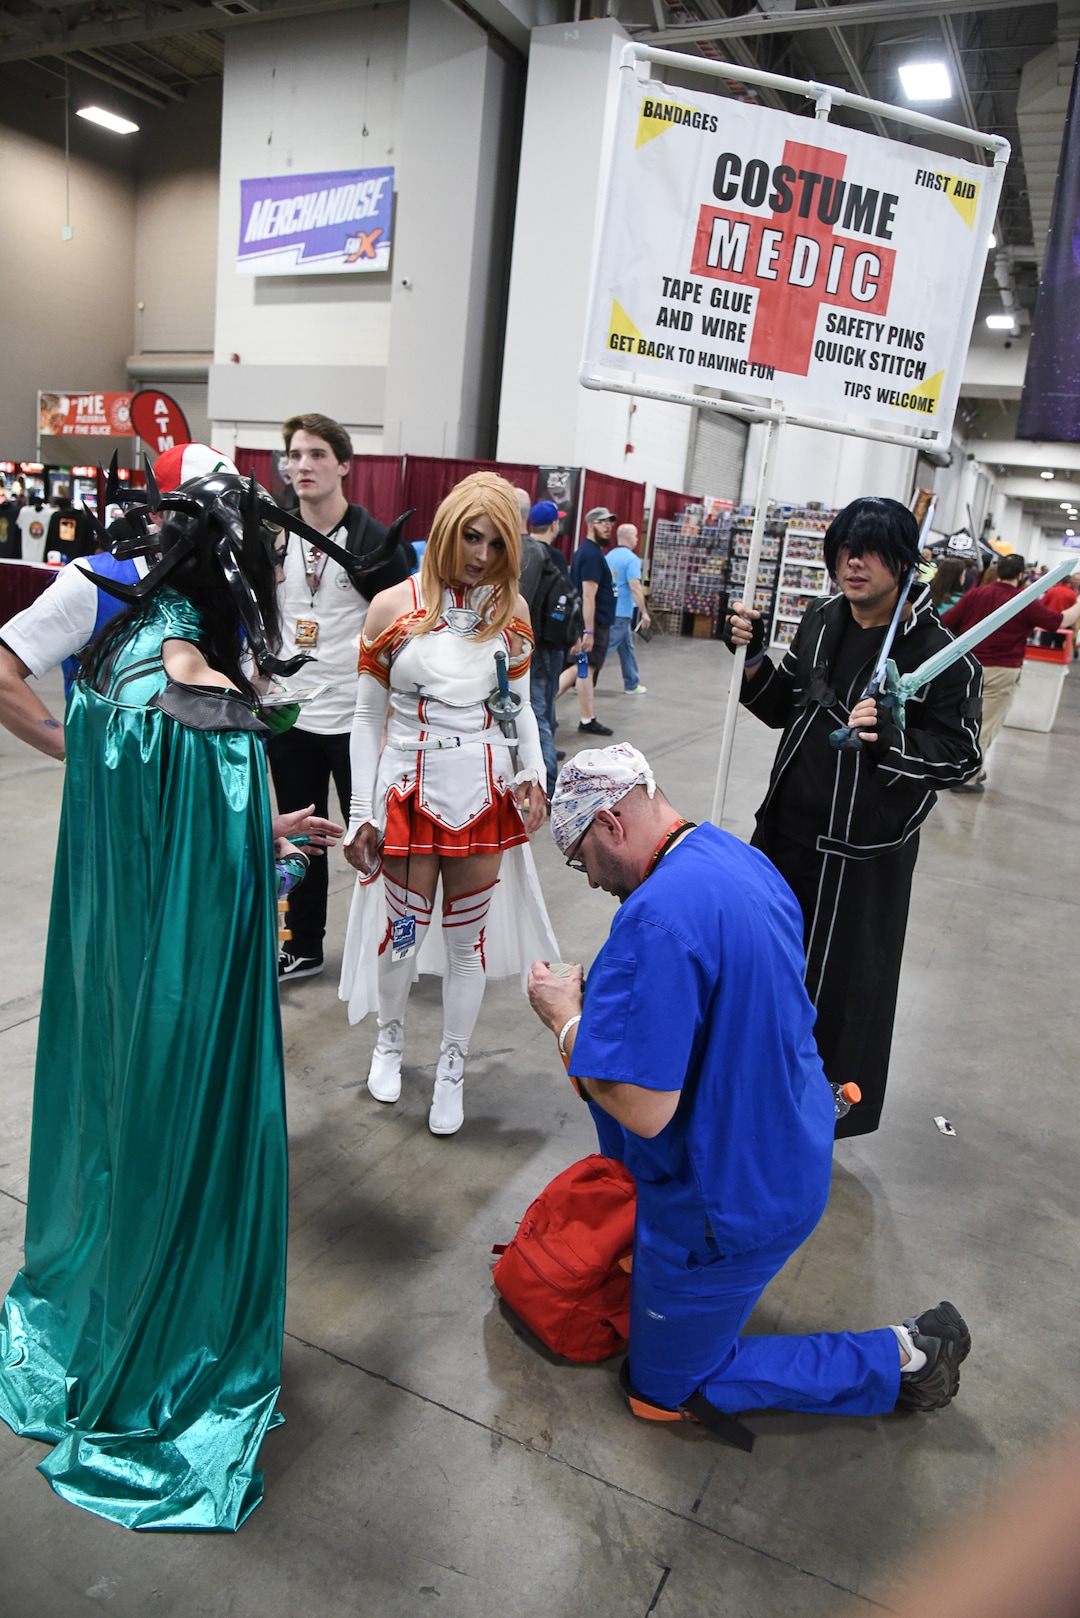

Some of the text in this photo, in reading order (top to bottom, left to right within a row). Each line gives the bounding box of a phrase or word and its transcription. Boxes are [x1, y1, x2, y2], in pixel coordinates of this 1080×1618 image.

[643, 100, 718, 133] BANDAGES
[712, 152, 899, 240] COSTUME
[915, 169, 976, 199] FIRST AID
[243, 176, 391, 244] MERCHANDISE
[706, 216, 882, 302] MEDIC
[662, 276, 753, 315] TAPE GLUE
[656, 306, 747, 343] AND WIRE
[825, 312, 925, 352] SAFETY PINS
[609, 333, 775, 381] GET BACK TO HAVING FUN
[814, 339, 927, 381] QUICK STITCH
[76, 395, 105, 415] PIE
[844, 381, 935, 413] TIPS WELCOME
[62, 424, 74, 435] BY
[75, 424, 89, 435] THE
[154, 398, 175, 453] ATM
